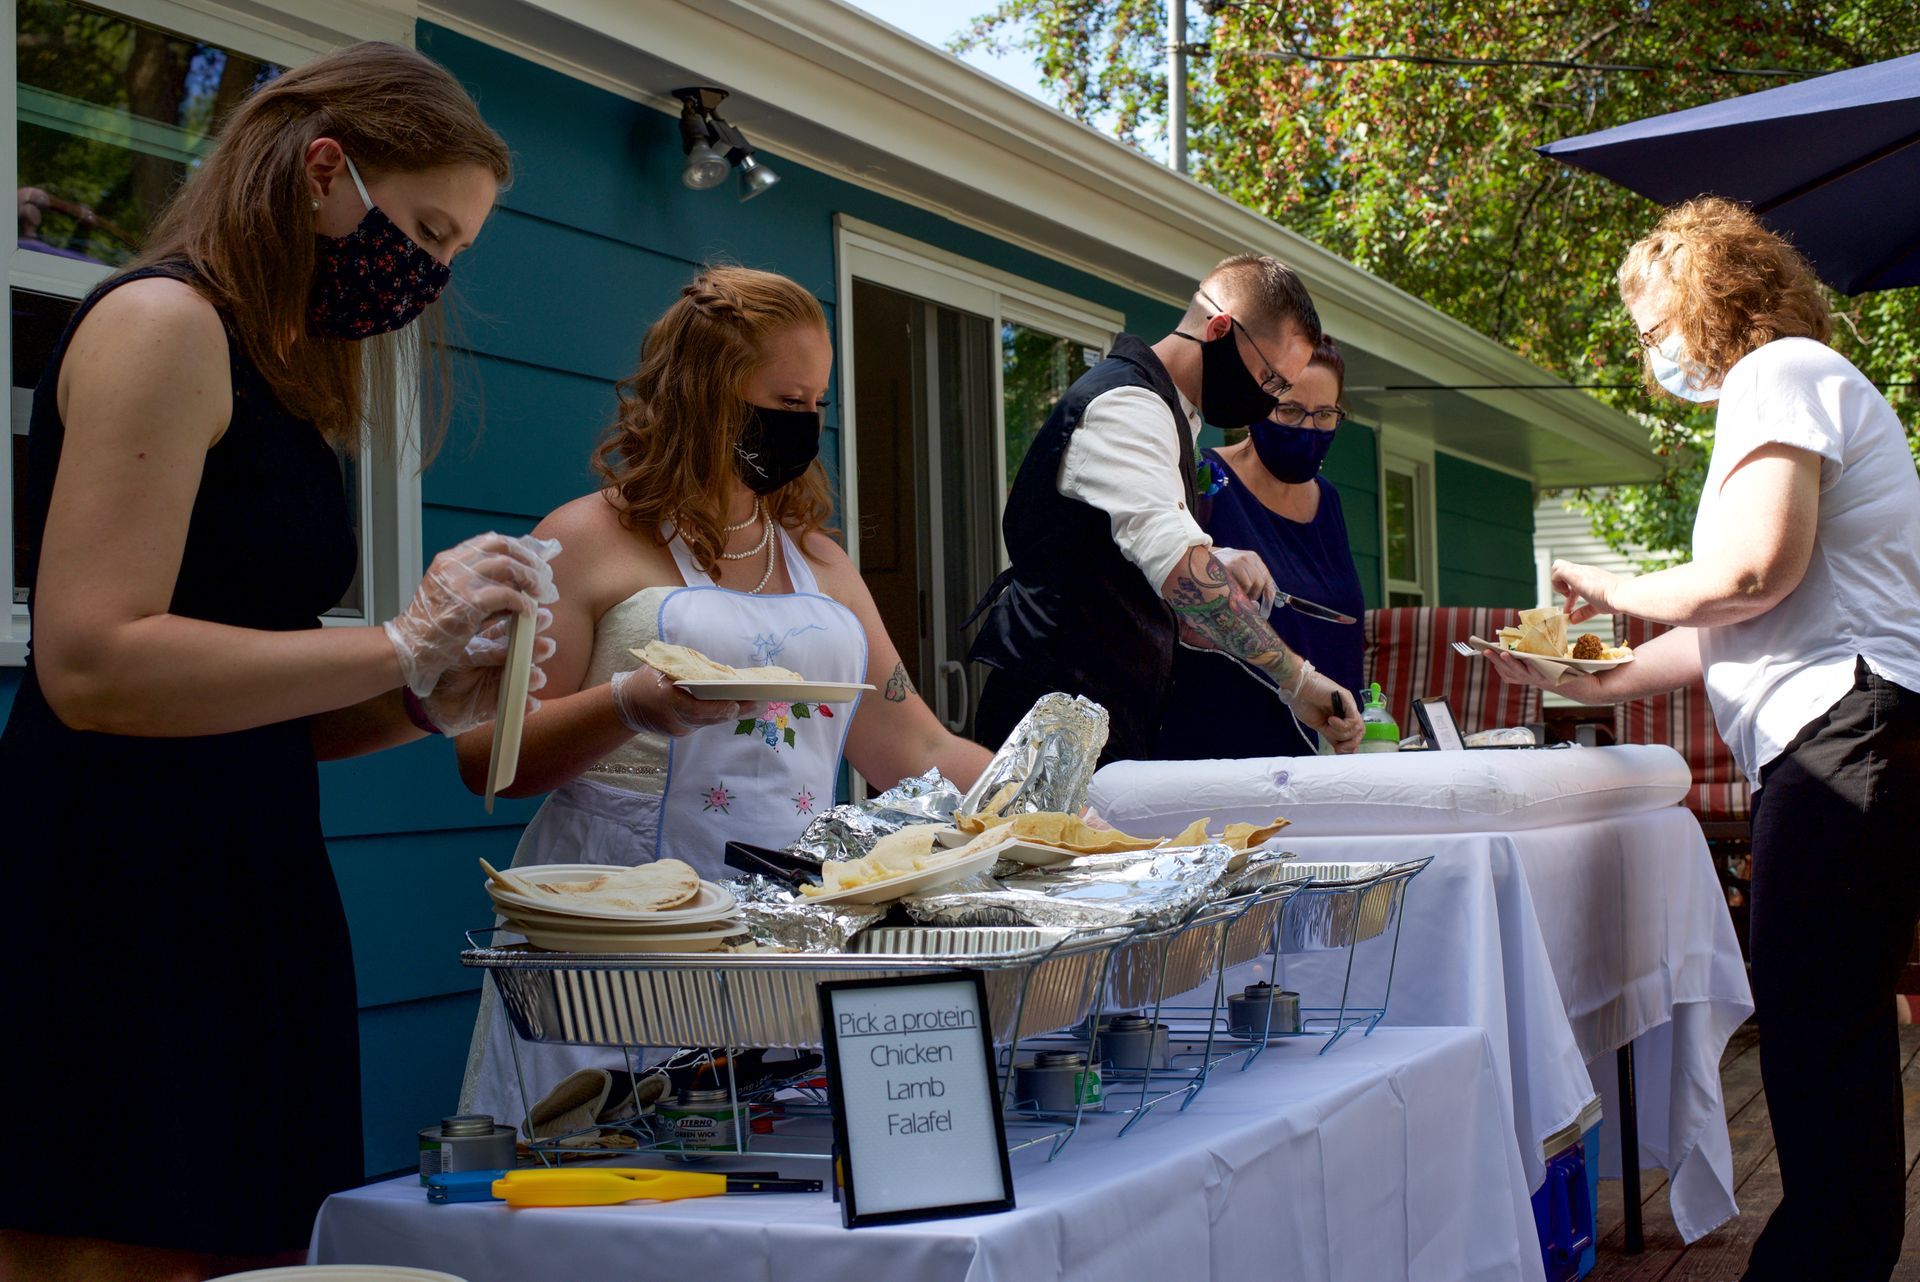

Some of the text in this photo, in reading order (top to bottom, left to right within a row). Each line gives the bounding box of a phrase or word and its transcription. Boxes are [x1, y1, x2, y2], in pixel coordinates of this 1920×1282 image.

[839, 1005, 976, 1036] Pick a protein
[870, 1042, 953, 1067] Chicken
[886, 1076, 945, 1101] Lamb
[680, 1119, 713, 1128] STERNO
[887, 1109, 953, 1136] Falafel
